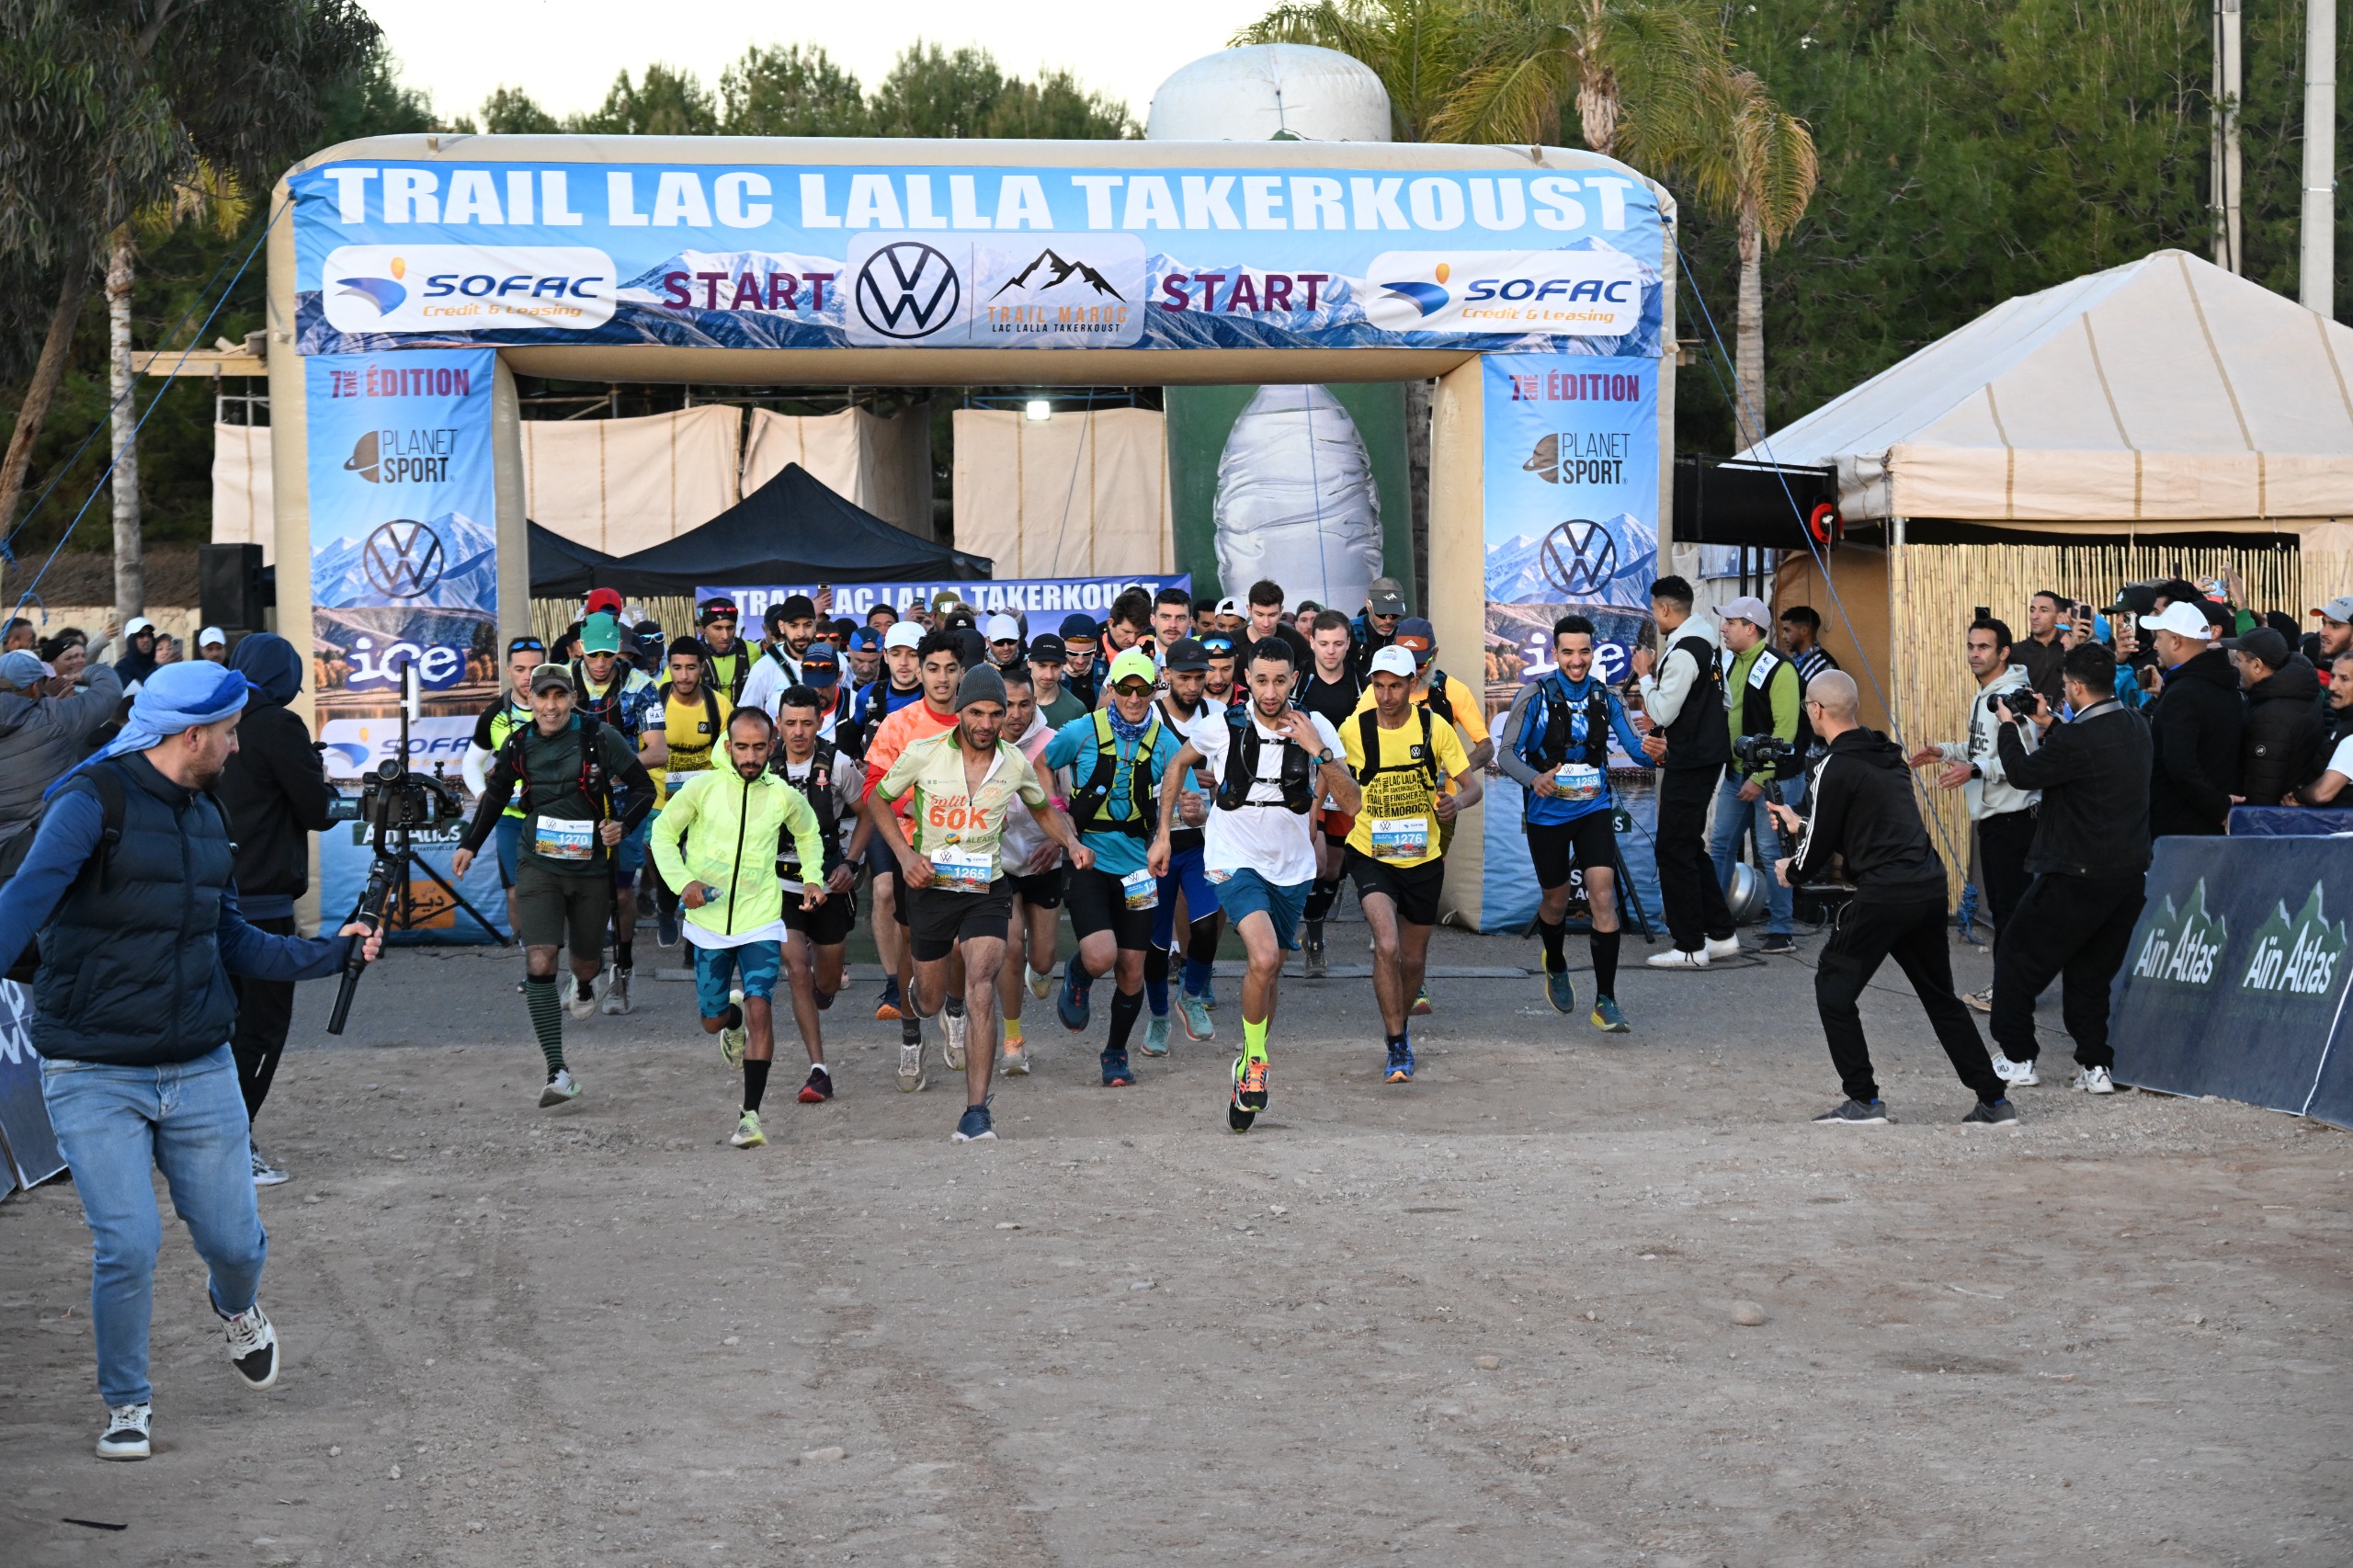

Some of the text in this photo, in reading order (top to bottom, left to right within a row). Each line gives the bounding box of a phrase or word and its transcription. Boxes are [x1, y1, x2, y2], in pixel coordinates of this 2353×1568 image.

[324, 167, 1633, 232] TRAIL LAC LALLA TAKERKOUST
[423, 275, 604, 299] SOFAC
[663, 270, 835, 312] START
[1161, 274, 1329, 313] START
[1464, 278, 1633, 303] SOFAC
[423, 302, 583, 318] Crédit & Leasing
[987, 306, 1128, 323] TRAIL MAROC
[1462, 306, 1615, 324] Crédit & Leasing
[992, 324, 1120, 333] LAC LALLA TAKERKOUST
[367, 364, 470, 397] ÉDITION
[1547, 369, 1640, 402] ÉDITION
[382, 428, 458, 455] PLANET
[1563, 432, 1631, 458] PLANET
[383, 457, 449, 483] SPORT
[1563, 460, 1623, 484] SPORT
[971, 583, 1159, 613] TAKERKOUT
[348, 637, 459, 683] ice
[1522, 631, 1625, 677] ie
[380, 736, 475, 756] SOFA
[1389, 775, 1401, 787] LAC
[1576, 775, 1598, 787] 1259
[930, 795, 967, 809] Split
[1367, 794, 1383, 805] TRAIL
[1390, 791, 1418, 802] FINISHER
[929, 806, 991, 831] 60K
[558, 833, 588, 846] 1270
[1393, 833, 1423, 845] 1276
[954, 867, 985, 880] 1265
[2132, 914, 2219, 984] Aïn Atlas
[2243, 920, 2337, 994] Aïn Atlas
